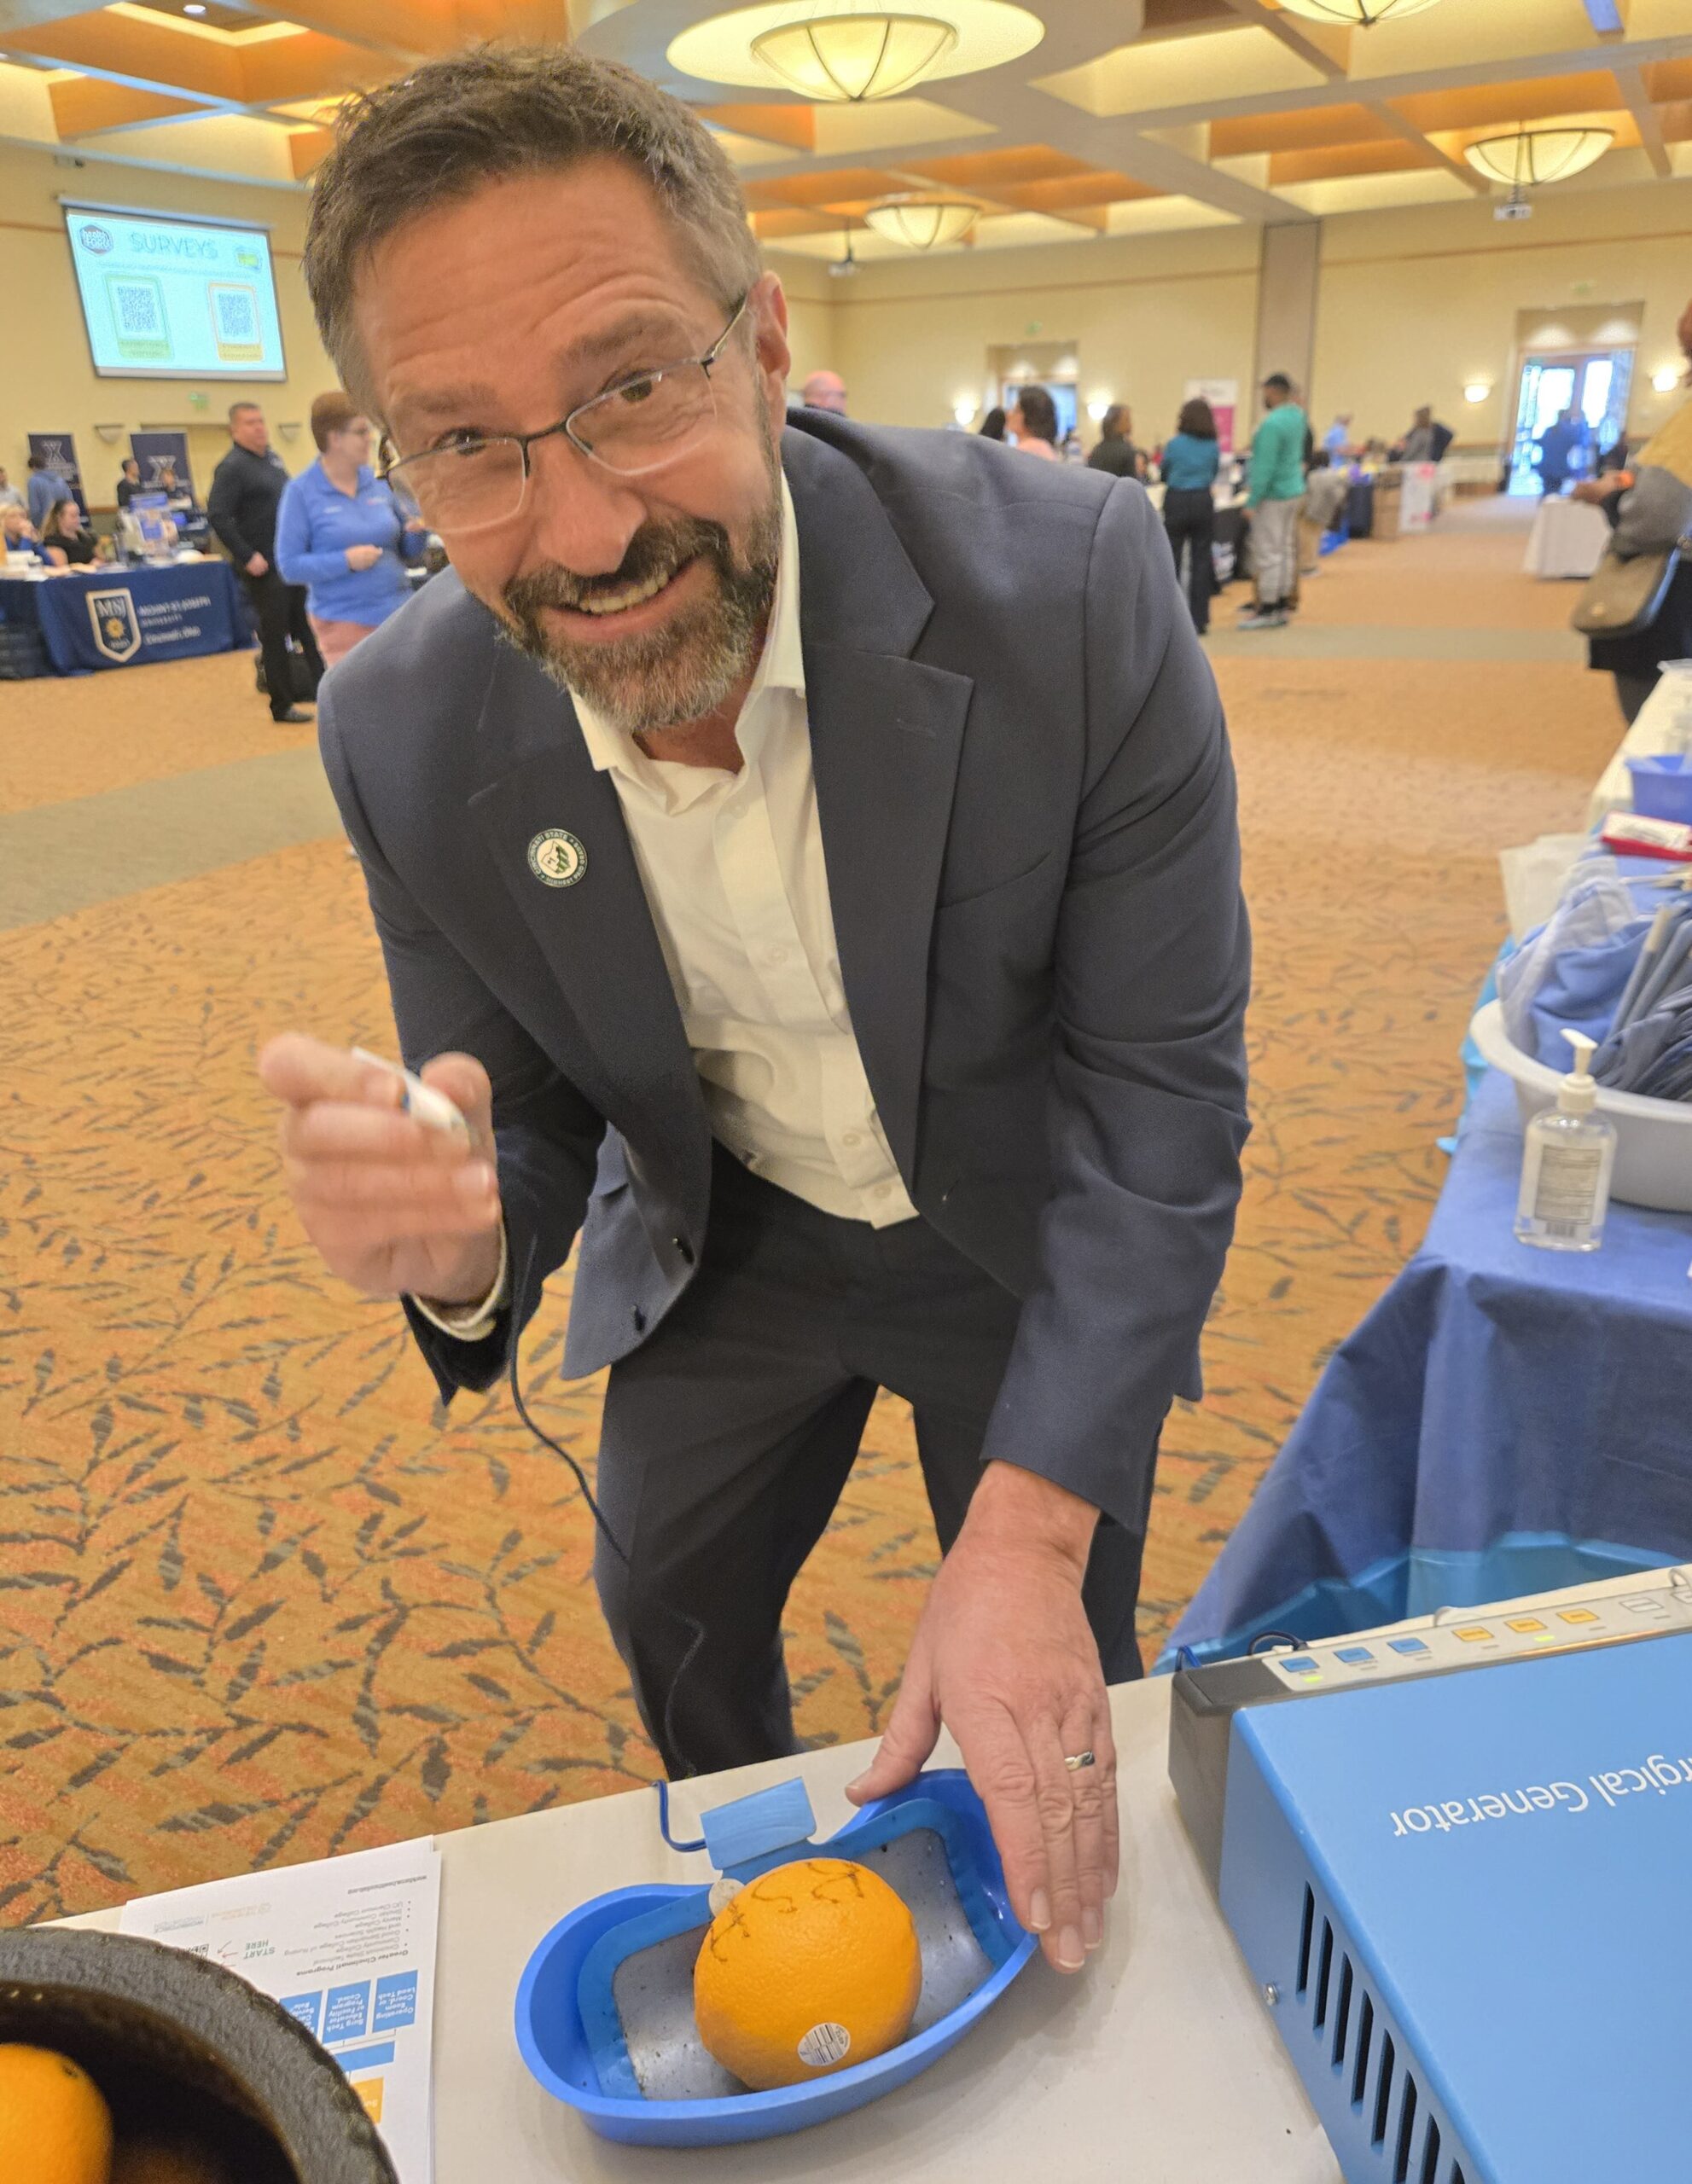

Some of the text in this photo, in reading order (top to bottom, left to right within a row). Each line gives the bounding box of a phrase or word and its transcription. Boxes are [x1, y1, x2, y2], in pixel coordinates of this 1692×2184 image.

[130, 231, 218, 261] SURVEYS
[95, 598, 127, 619] MSJ
[544, 831, 568, 841] STATE
[1390, 1754, 1692, 1838] rgical Generator
[334, 1909, 360, 1919] College
[341, 1914, 377, 1924] Community
[313, 1920, 340, 1929] College
[355, 1920, 381, 1928] College
[246, 1939, 269, 1950] HERE
[319, 1940, 345, 1949] College
[336, 1943, 363, 1953] College
[243, 1946, 276, 1960] START
[296, 1949, 409, 1976] Greater Cincinnati Programs
[378, 1986, 416, 1999] Lead Tech
[332, 1999, 363, 2010] Program
[329, 2012, 363, 2024] Educator
[375, 2007, 414, 2020] Operating
[327, 2023, 346, 2033] Tech
